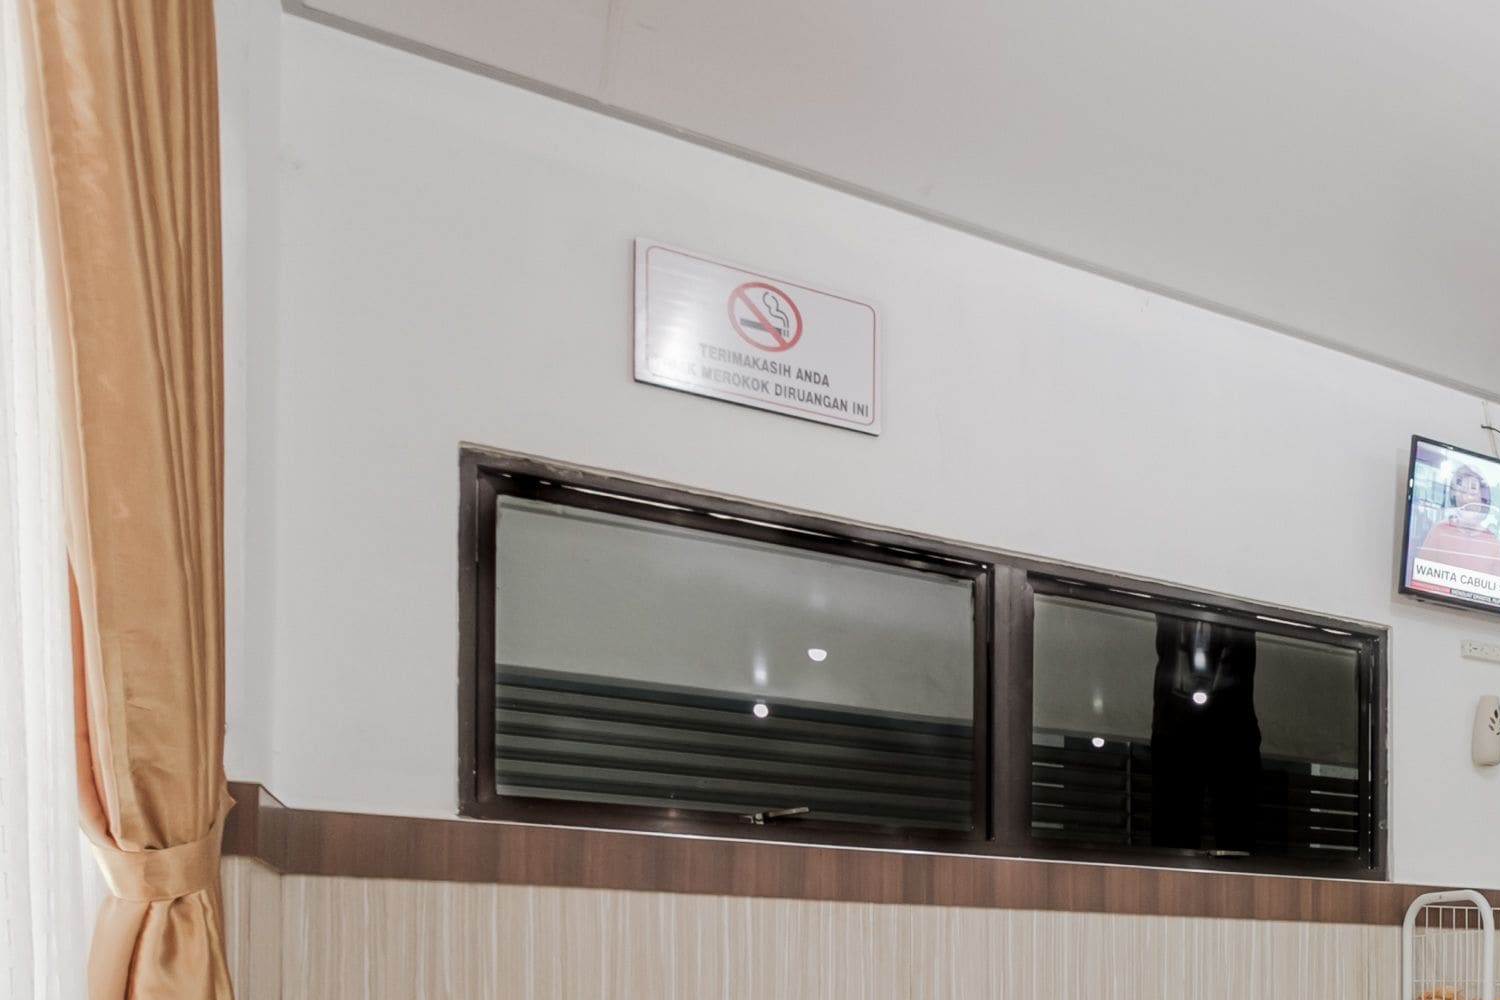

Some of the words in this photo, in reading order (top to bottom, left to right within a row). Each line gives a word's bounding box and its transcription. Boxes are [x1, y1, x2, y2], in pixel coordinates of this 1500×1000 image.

[699, 343, 792, 378] TERIMAKASIH
[796, 368, 830, 387] ANDA
[702, 365, 770, 394] MEROKOK
[774, 383, 848, 412] DIRUANGAN
[852, 402, 869, 417] INI
[1416, 564, 1457, 582] WANITA
[1460, 574, 1497, 591] CABULI
